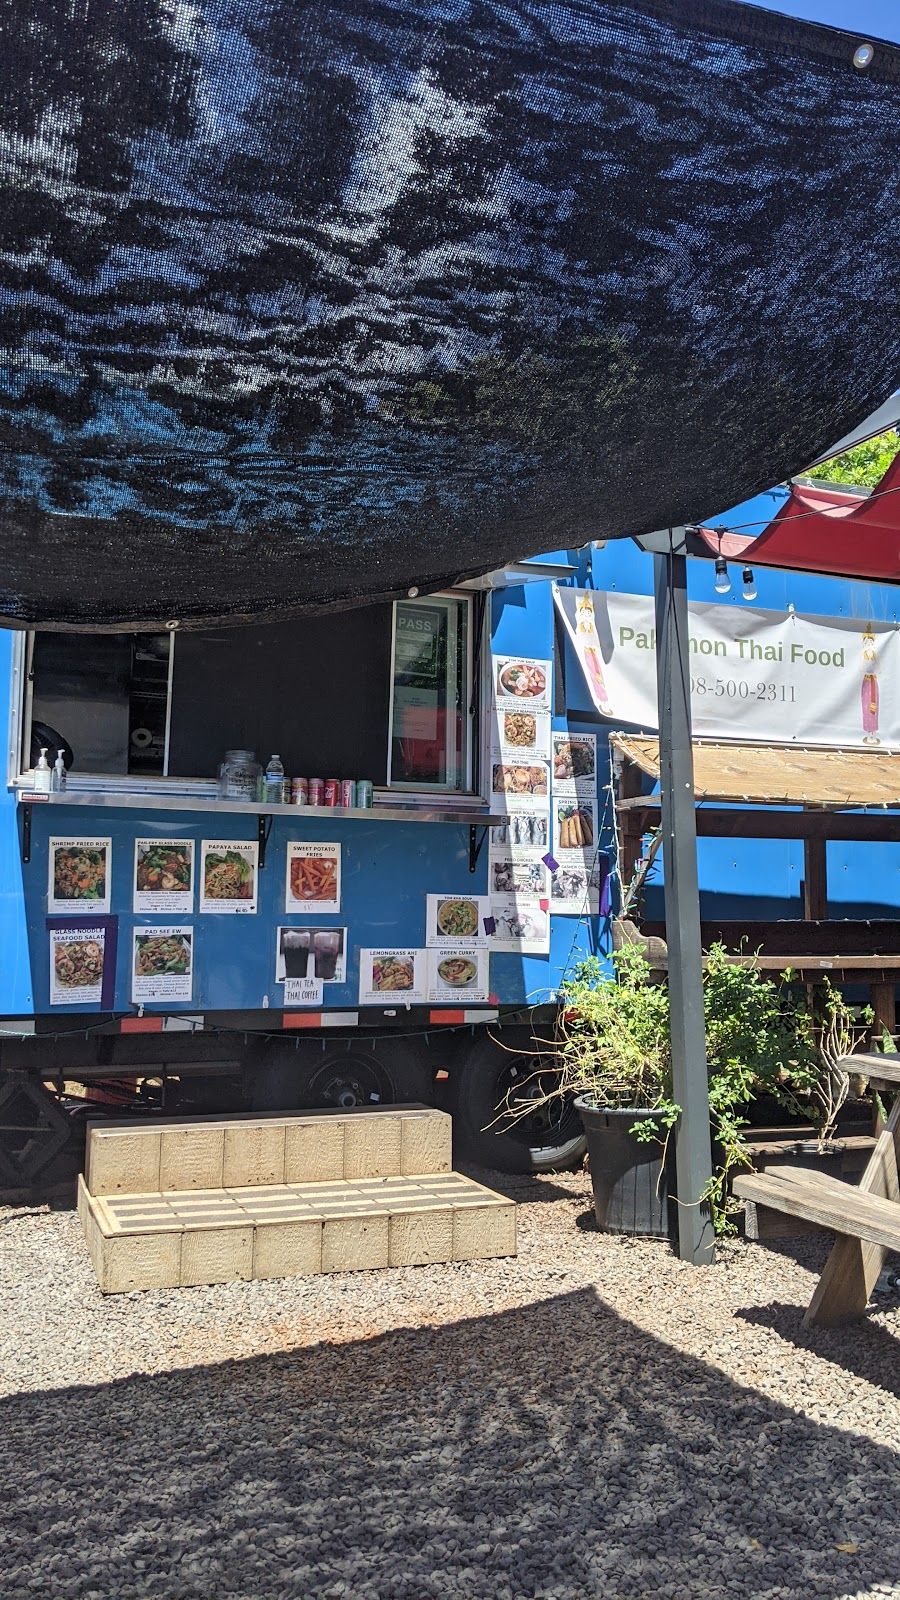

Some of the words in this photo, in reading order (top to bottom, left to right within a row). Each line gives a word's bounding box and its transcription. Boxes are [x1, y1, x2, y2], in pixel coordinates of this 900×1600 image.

[398, 617, 432, 632] PASS
[735, 637, 783, 662] Thai
[790, 643, 846, 668] Food
[286, 980, 302, 989] THAI
[304, 979, 314, 988] TEA
[286, 991, 301, 1001] THAI
[301, 989, 319, 1000] COFFEE
